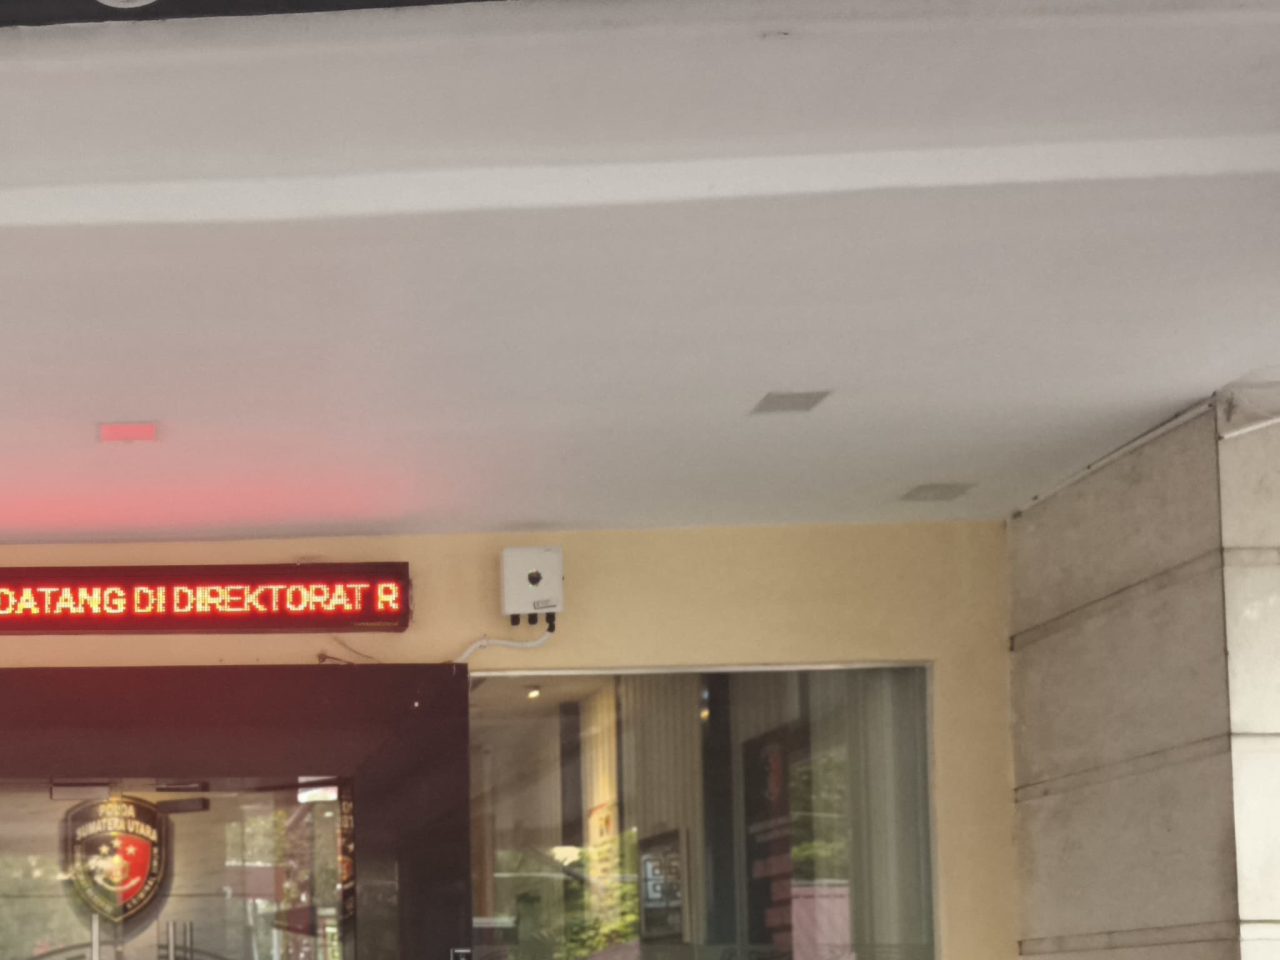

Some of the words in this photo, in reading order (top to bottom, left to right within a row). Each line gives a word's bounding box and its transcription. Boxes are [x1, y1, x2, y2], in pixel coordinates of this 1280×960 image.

[133, 586, 166, 613] DI
[172, 584, 370, 613] DIREKTORAT
[377, 583, 399, 610] R
